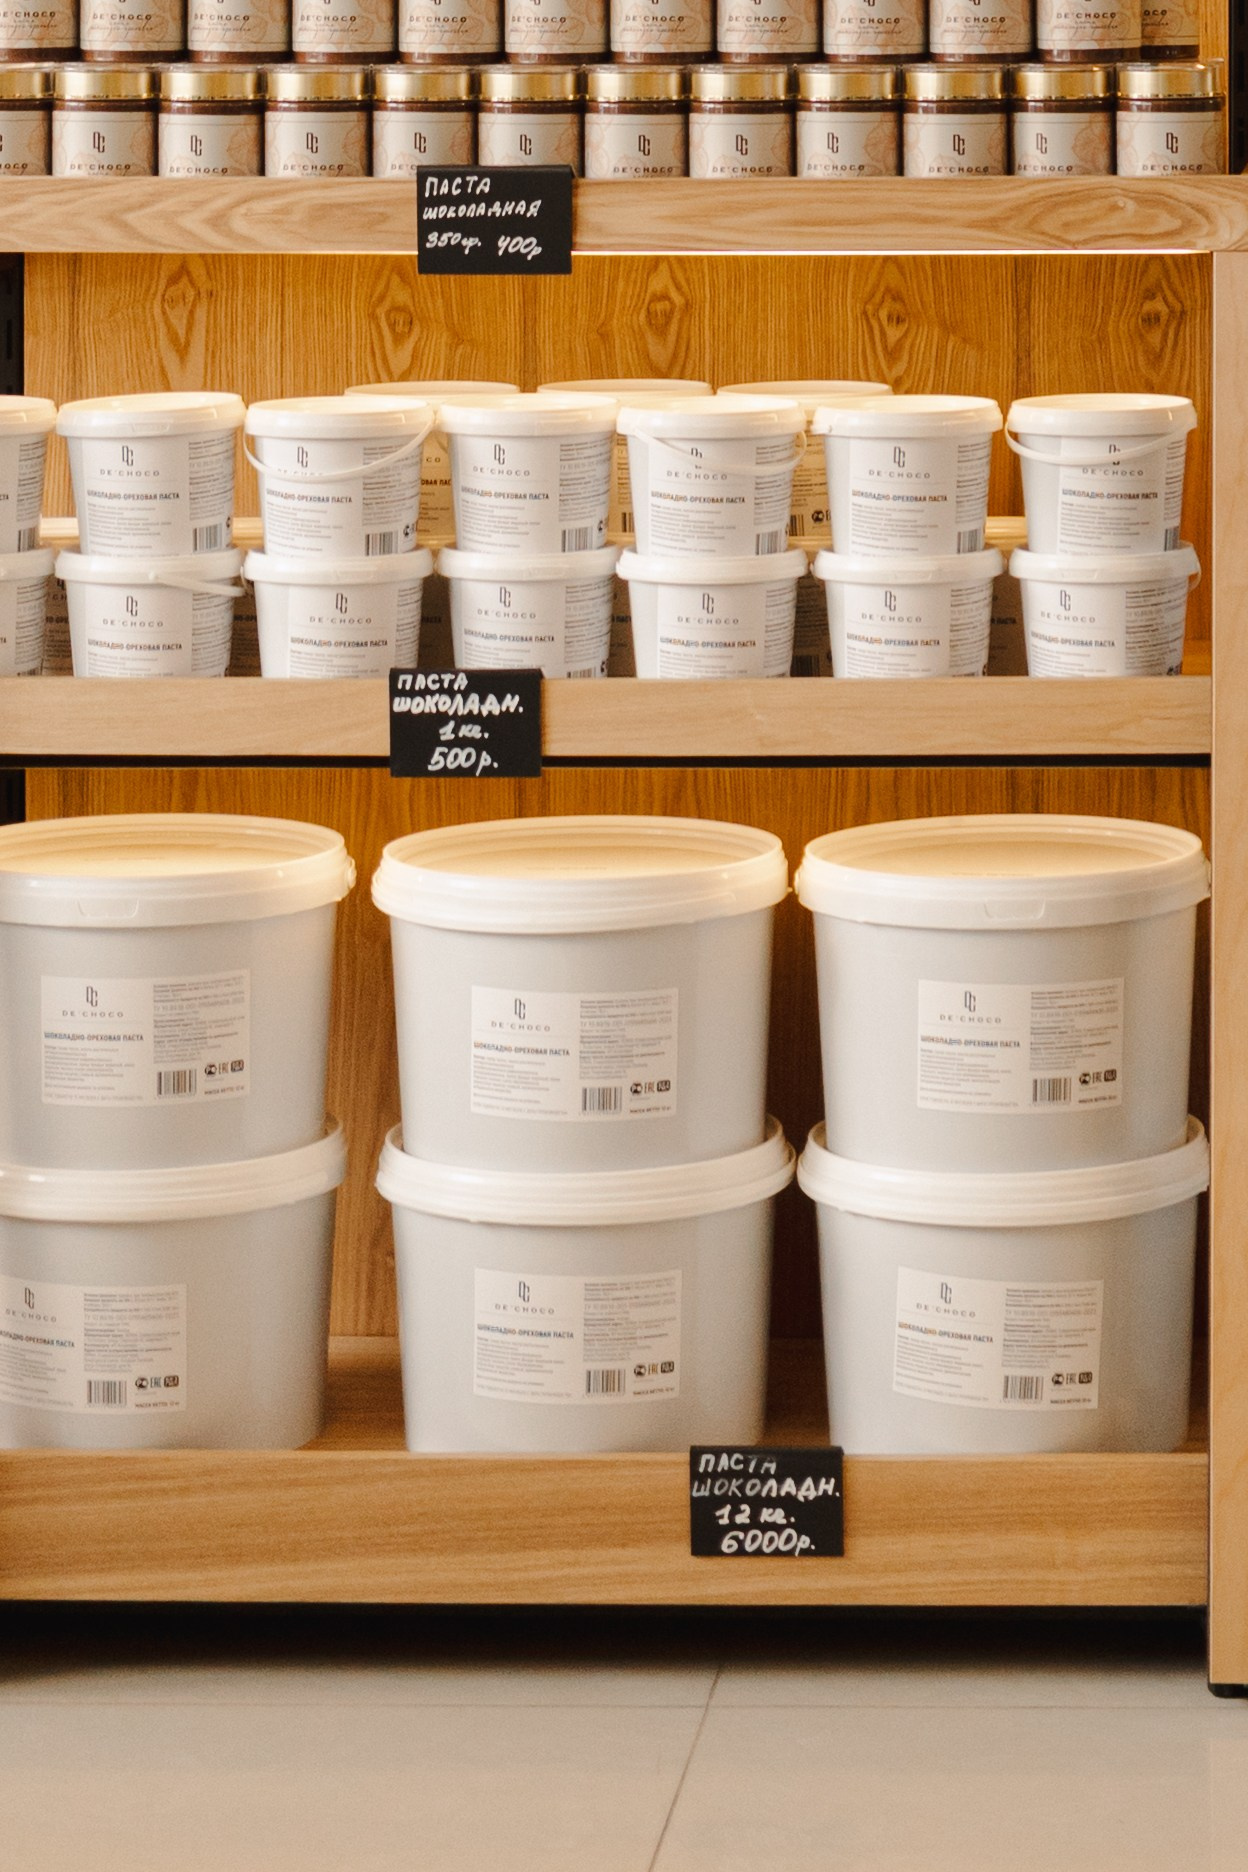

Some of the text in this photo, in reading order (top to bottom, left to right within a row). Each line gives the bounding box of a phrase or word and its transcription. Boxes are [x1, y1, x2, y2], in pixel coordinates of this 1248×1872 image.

[425, 176, 490, 198] ПАСТА
[423, 199, 541, 220] ШОКОЛАДНАЯ
[159, 492, 179, 500] ПАСТА
[529, 492, 549, 501] ПАСТА
[929, 494, 947, 503] ПАСТА
[162, 643, 182, 651] ПАСТА
[398, 672, 468, 690] ПАСТА
[393, 693, 523, 717] ШОКОЛАДН.
[439, 720, 455, 740] 1
[123, 1033, 143, 1042] ПАСТА
[1000, 1040, 1020, 1048] ПАСТА
[549, 1048, 570, 1057] ПАСТА
[553, 1331, 573, 1339] ПАСТА
[973, 1334, 993, 1344] ПАСТА
[699, 1453, 776, 1474] ПАСТА
[692, 1477, 840, 1502] ШОКОЛАДН.
[715, 1504, 750, 1525] 12
